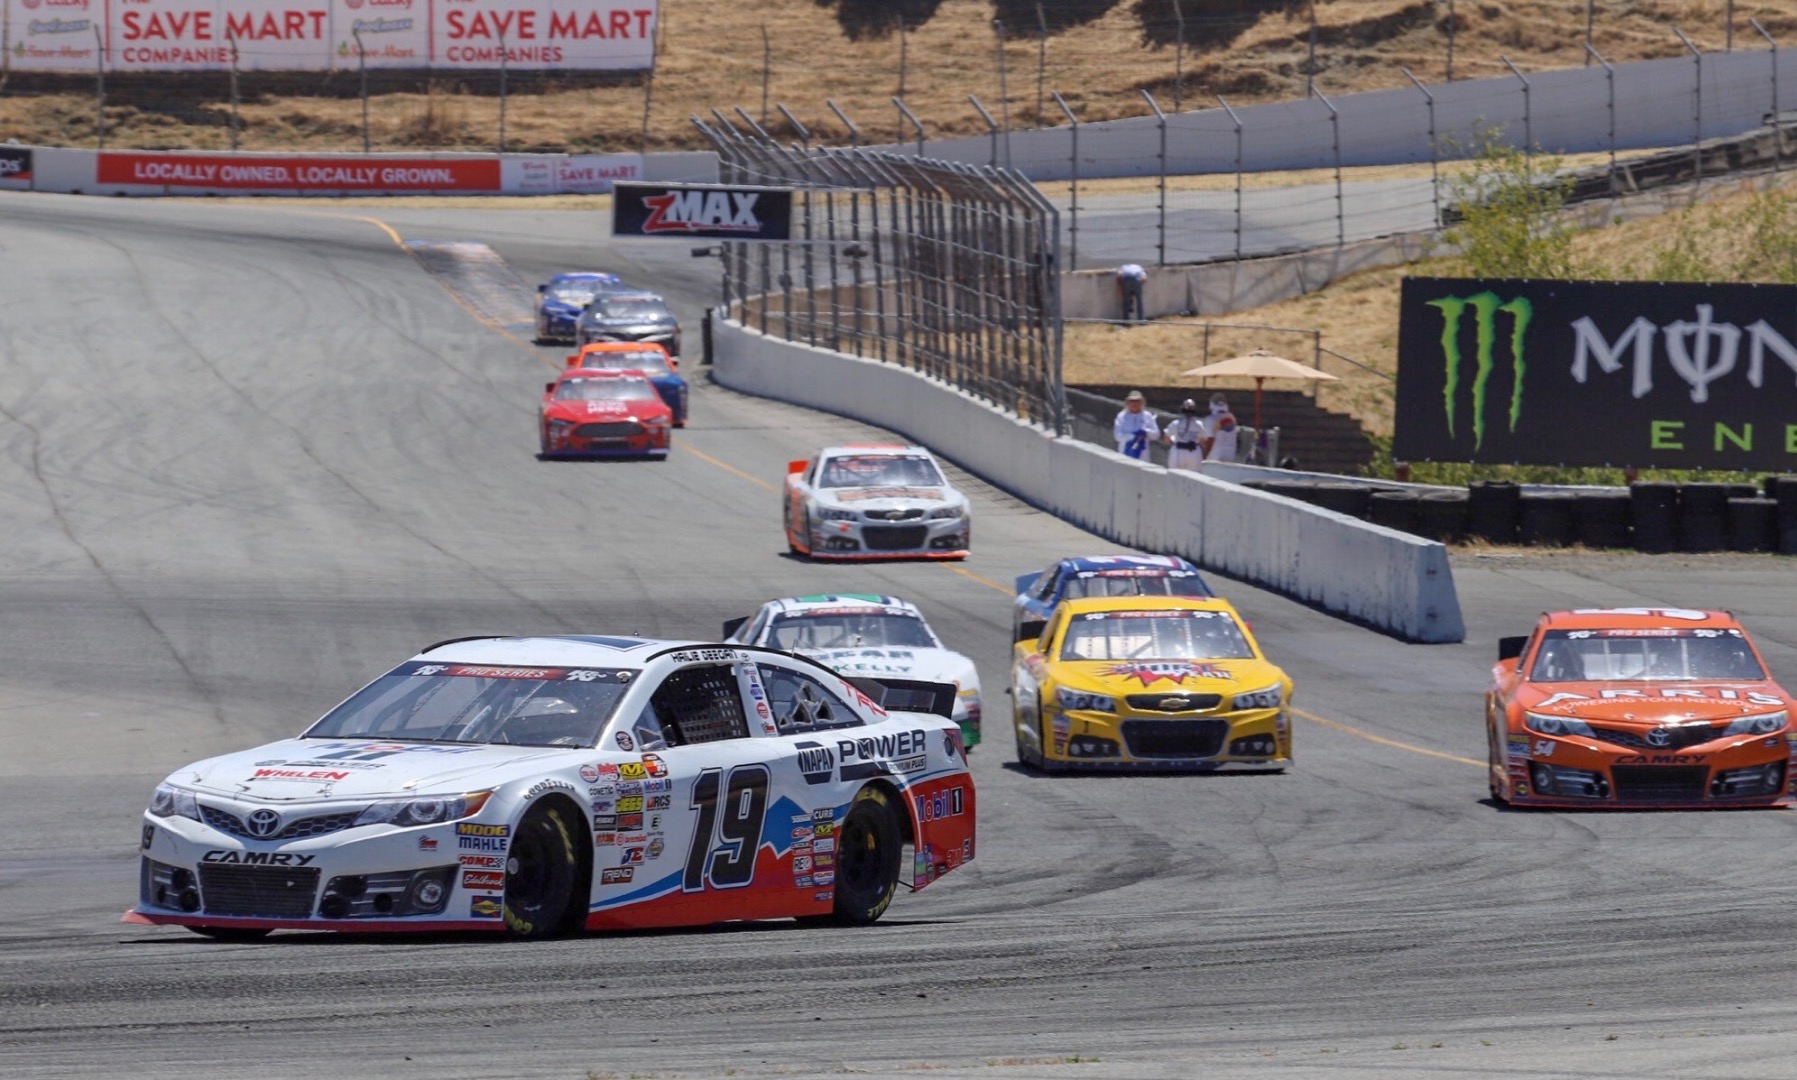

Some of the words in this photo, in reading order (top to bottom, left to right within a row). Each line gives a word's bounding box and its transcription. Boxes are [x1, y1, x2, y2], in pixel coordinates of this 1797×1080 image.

[122, 11, 212, 40] SAVE
[224, 11, 327, 40] MART
[446, 10, 536, 39] SAVE
[548, 10, 652, 39] MART
[123, 47, 239, 63] COMPANIES
[446, 46, 563, 62] COMPANIES
[134, 162, 216, 180] LOCALLY
[219, 165, 293, 183] OWNED.
[296, 166, 377, 184] LOCALLY
[381, 168, 455, 184] GROWN.
[559, 168, 593, 181] SAVE
[598, 166, 637, 179] MART
[1637, 629, 1679, 637] SERIES
[457, 667, 488, 676] PRO
[491, 668, 548, 678] SERIES
[1535, 688, 1786, 708] ARRIS
[1553, 698, 1634, 712] POWERING
[1640, 697, 1684, 705] YOUR
[1690, 697, 1766, 711] NETWORK
[837, 729, 926, 762] POWER
[1533, 740, 1557, 757] 54
[801, 748, 830, 773] NAPA
[912, 758, 924, 769] PLUS
[1615, 754, 1706, 764] CAMRY
[254, 768, 351, 781] WHELEN
[523, 778, 577, 800] GOODYEAR
[644, 780, 664, 791] Mobil
[913, 789, 950, 822] Mobil
[952, 789, 962, 814] 1
[814, 809, 834, 820] CURB
[457, 824, 508, 837] MOOG
[682, 762, 772, 893] 19
[459, 837, 507, 851] MAHLE
[202, 851, 315, 866] CAMRY
[458, 856, 494, 867] COMP
[621, 847, 645, 865] JE
[603, 869, 634, 881] TREND
